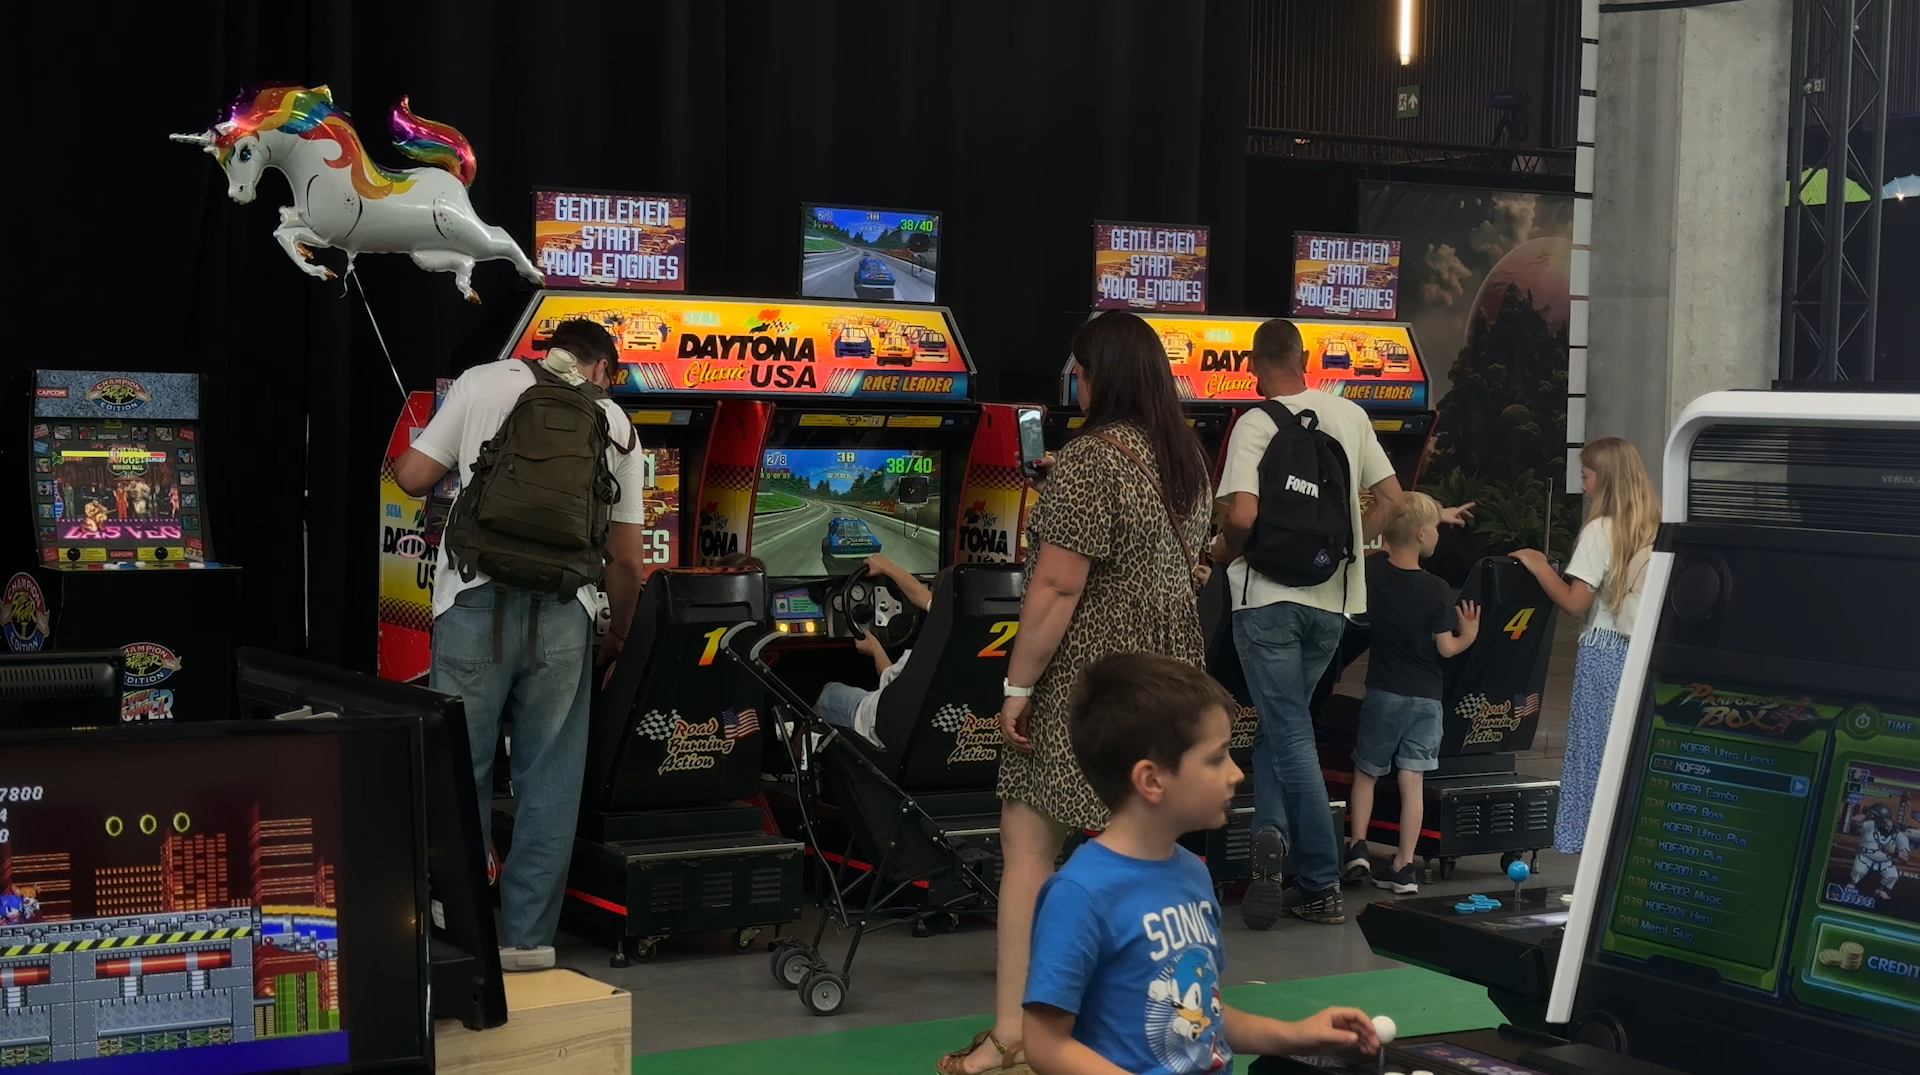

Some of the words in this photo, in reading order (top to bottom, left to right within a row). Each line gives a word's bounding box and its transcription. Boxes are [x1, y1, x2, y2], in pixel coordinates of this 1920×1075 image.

[555, 196, 670, 227] GENTLEMEN
[900, 219, 933, 232] 38/40
[581, 225, 642, 252] START
[1111, 228, 1196, 254] GENTLEMEN
[1309, 239, 1390, 264] GENTLEMEN
[543, 250, 593, 278] YOUR
[602, 253, 679, 280] ENGINES
[1130, 254, 1175, 277] START
[1327, 263, 1370, 286] START
[1101, 278, 1138, 300] YOUR
[1144, 279, 1201, 302] ENGINES
[1300, 286, 1334, 307] YOUR
[1340, 288, 1393, 310] ENGINES
[684, 311, 721, 326] SEGA
[677, 333, 816, 363] DAYTONA
[1200, 350, 1254, 372] DAYT
[683, 360, 750, 389] Classic
[751, 364, 817, 389] USA
[861, 375, 900, 391] RACE
[901, 376, 954, 393] LEADER
[36, 389, 67, 397] CAPCOM
[1342, 385, 1370, 399] RACE
[1373, 385, 1414, 399] LEADER
[100, 402, 138, 411] EDITION
[886, 457, 933, 474] 38/40
[1284, 474, 1320, 499] FORTN
[383, 525, 440, 562] DAYTON
[1501, 607, 1536, 640] 4
[698, 626, 728, 667] 1
[977, 620, 1020, 658] 2
[124, 645, 168, 658] HAMPION
[124, 671, 165, 684] DITION
[1480, 699, 1513, 717] Road
[1695, 705, 1772, 729] BOX
[674, 717, 719, 738] Road
[962, 712, 1001, 731] Road
[1472, 714, 1522, 732] Burning
[667, 735, 736, 755] Burning
[956, 729, 1004, 746] Burnin
[1462, 729, 1505, 750] Action
[657, 752, 715, 776] Action
[947, 745, 998, 766] Action
[1653, 757, 1673, 769] 032
[1714, 747, 1739, 760] Ultra
[0, 786, 44, 802] 7800
[1671, 781, 1702, 794] KOF99
[1705, 786, 1739, 802] Combo
[1667, 800, 1698, 815] KOF99
[1701, 807, 1725, 820] Boss
[1662, 820, 1694, 835] KOF99
[1697, 827, 1722, 841] Ultra
[1726, 833, 1748, 846] Plus
[1658, 840, 1699, 857] KOF2000
[1703, 849, 1724, 862] Plus
[1653, 860, 1694, 877] KOF2001
[1699, 869, 1720, 883] Plus
[1649, 880, 1691, 897] KOF2002
[1694, 890, 1724, 905] Magic
[1645, 900, 1686, 917] KOF2004
[1690, 910, 1713, 924] Hero
[1142, 900, 1217, 962] SONIC
[1640, 920, 1669, 935] Metal
[1672, 927, 1694, 942] Slug
[1867, 955, 1920, 978] CREDIT
